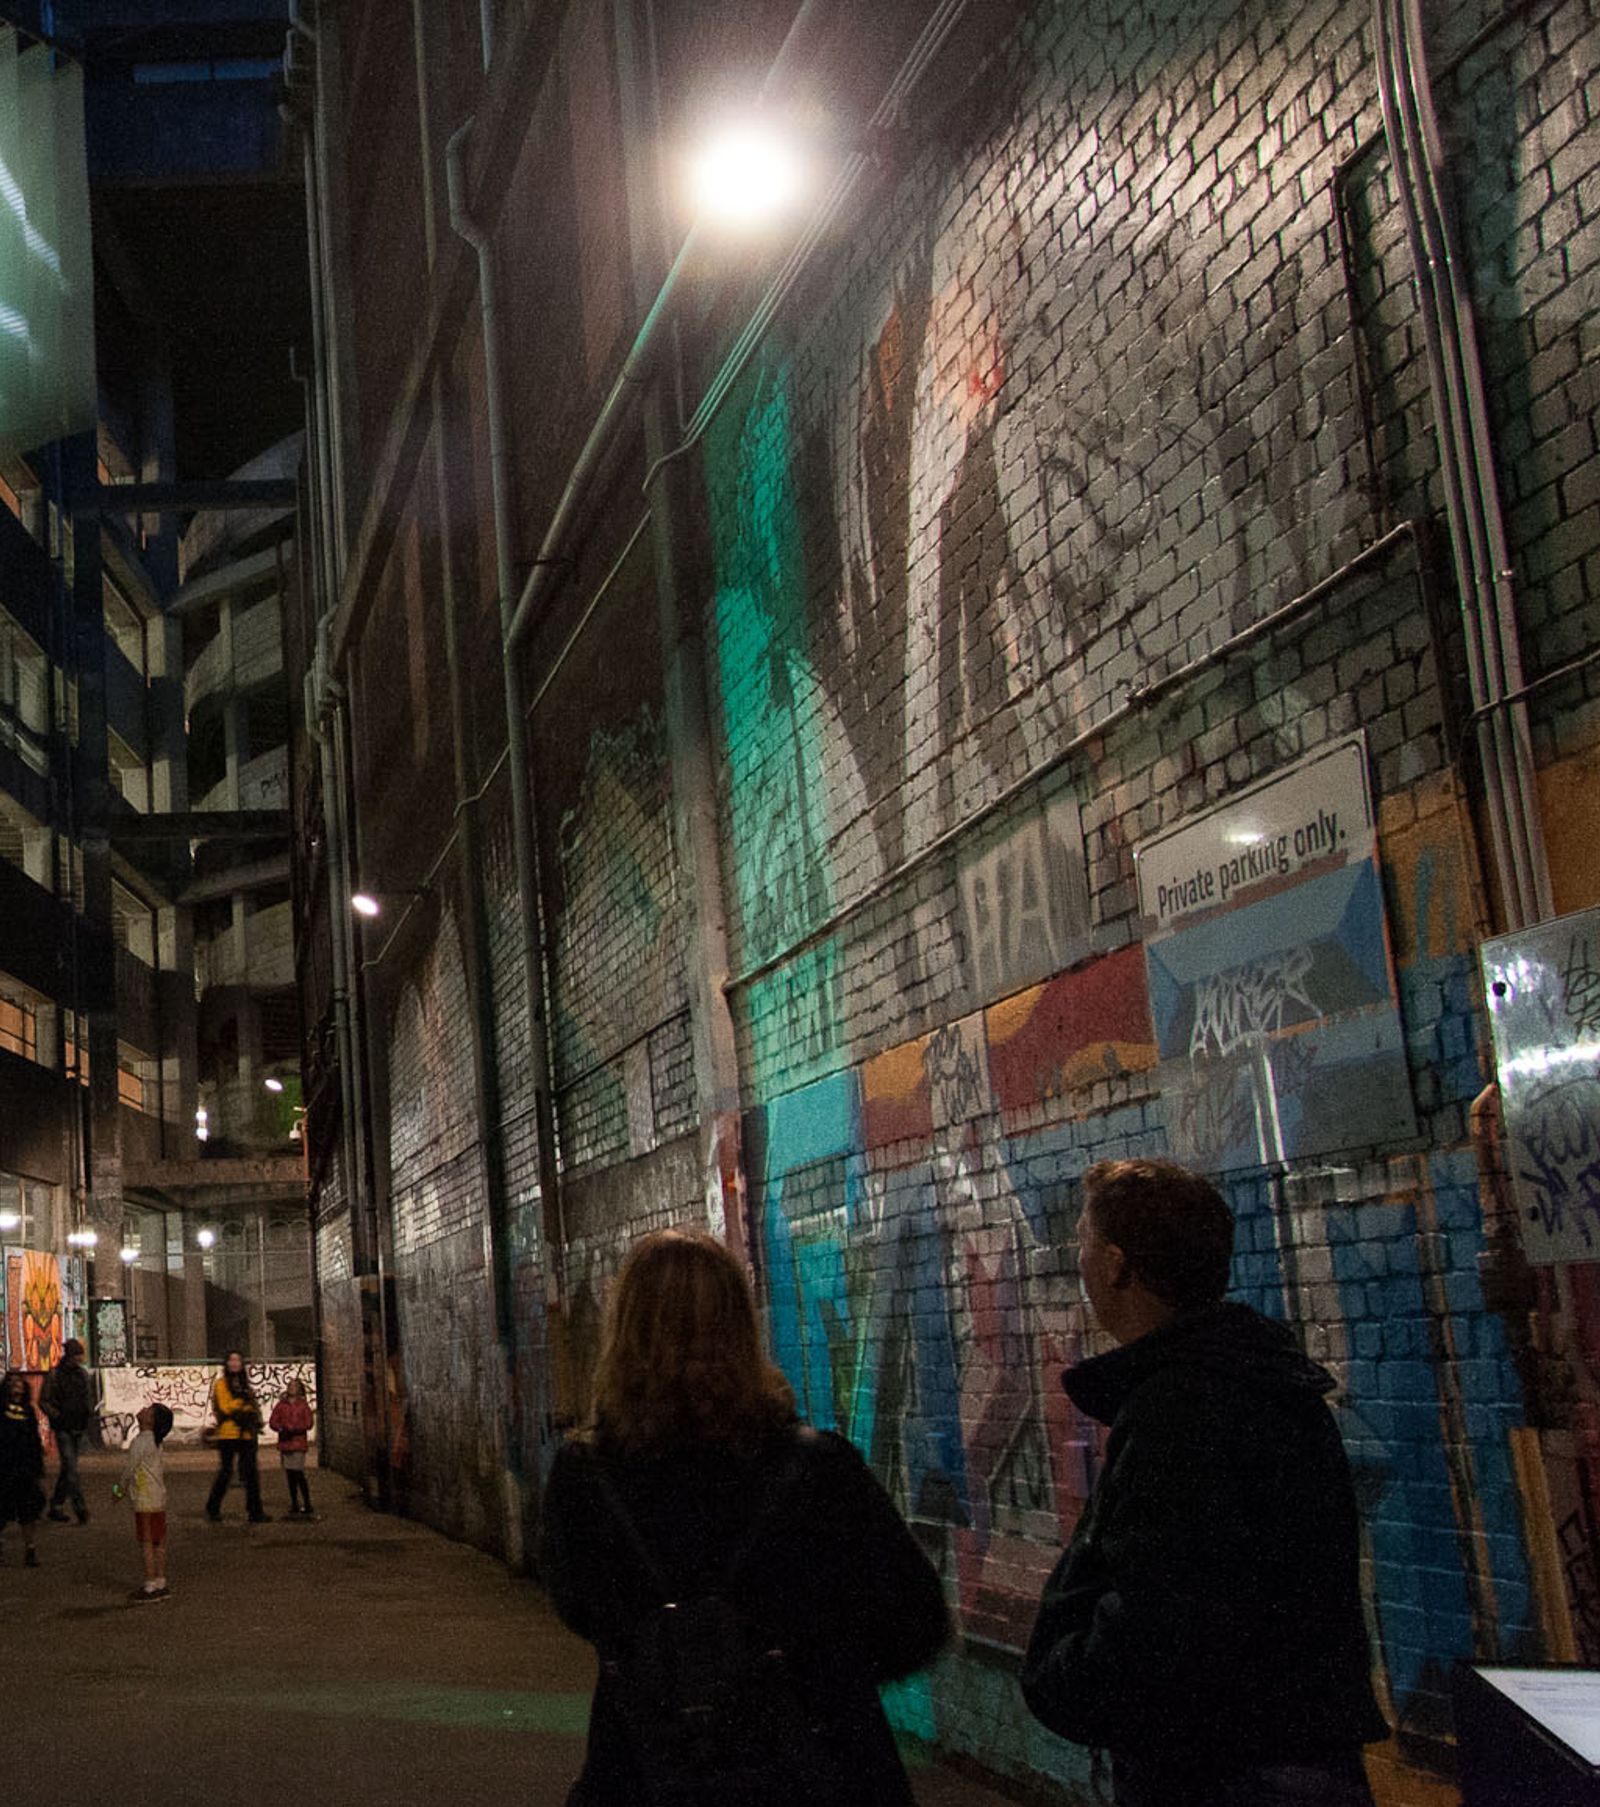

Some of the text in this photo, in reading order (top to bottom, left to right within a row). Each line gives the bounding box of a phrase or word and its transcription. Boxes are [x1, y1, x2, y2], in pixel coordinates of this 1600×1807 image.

[1157, 808, 1346, 918] Private parking only.
